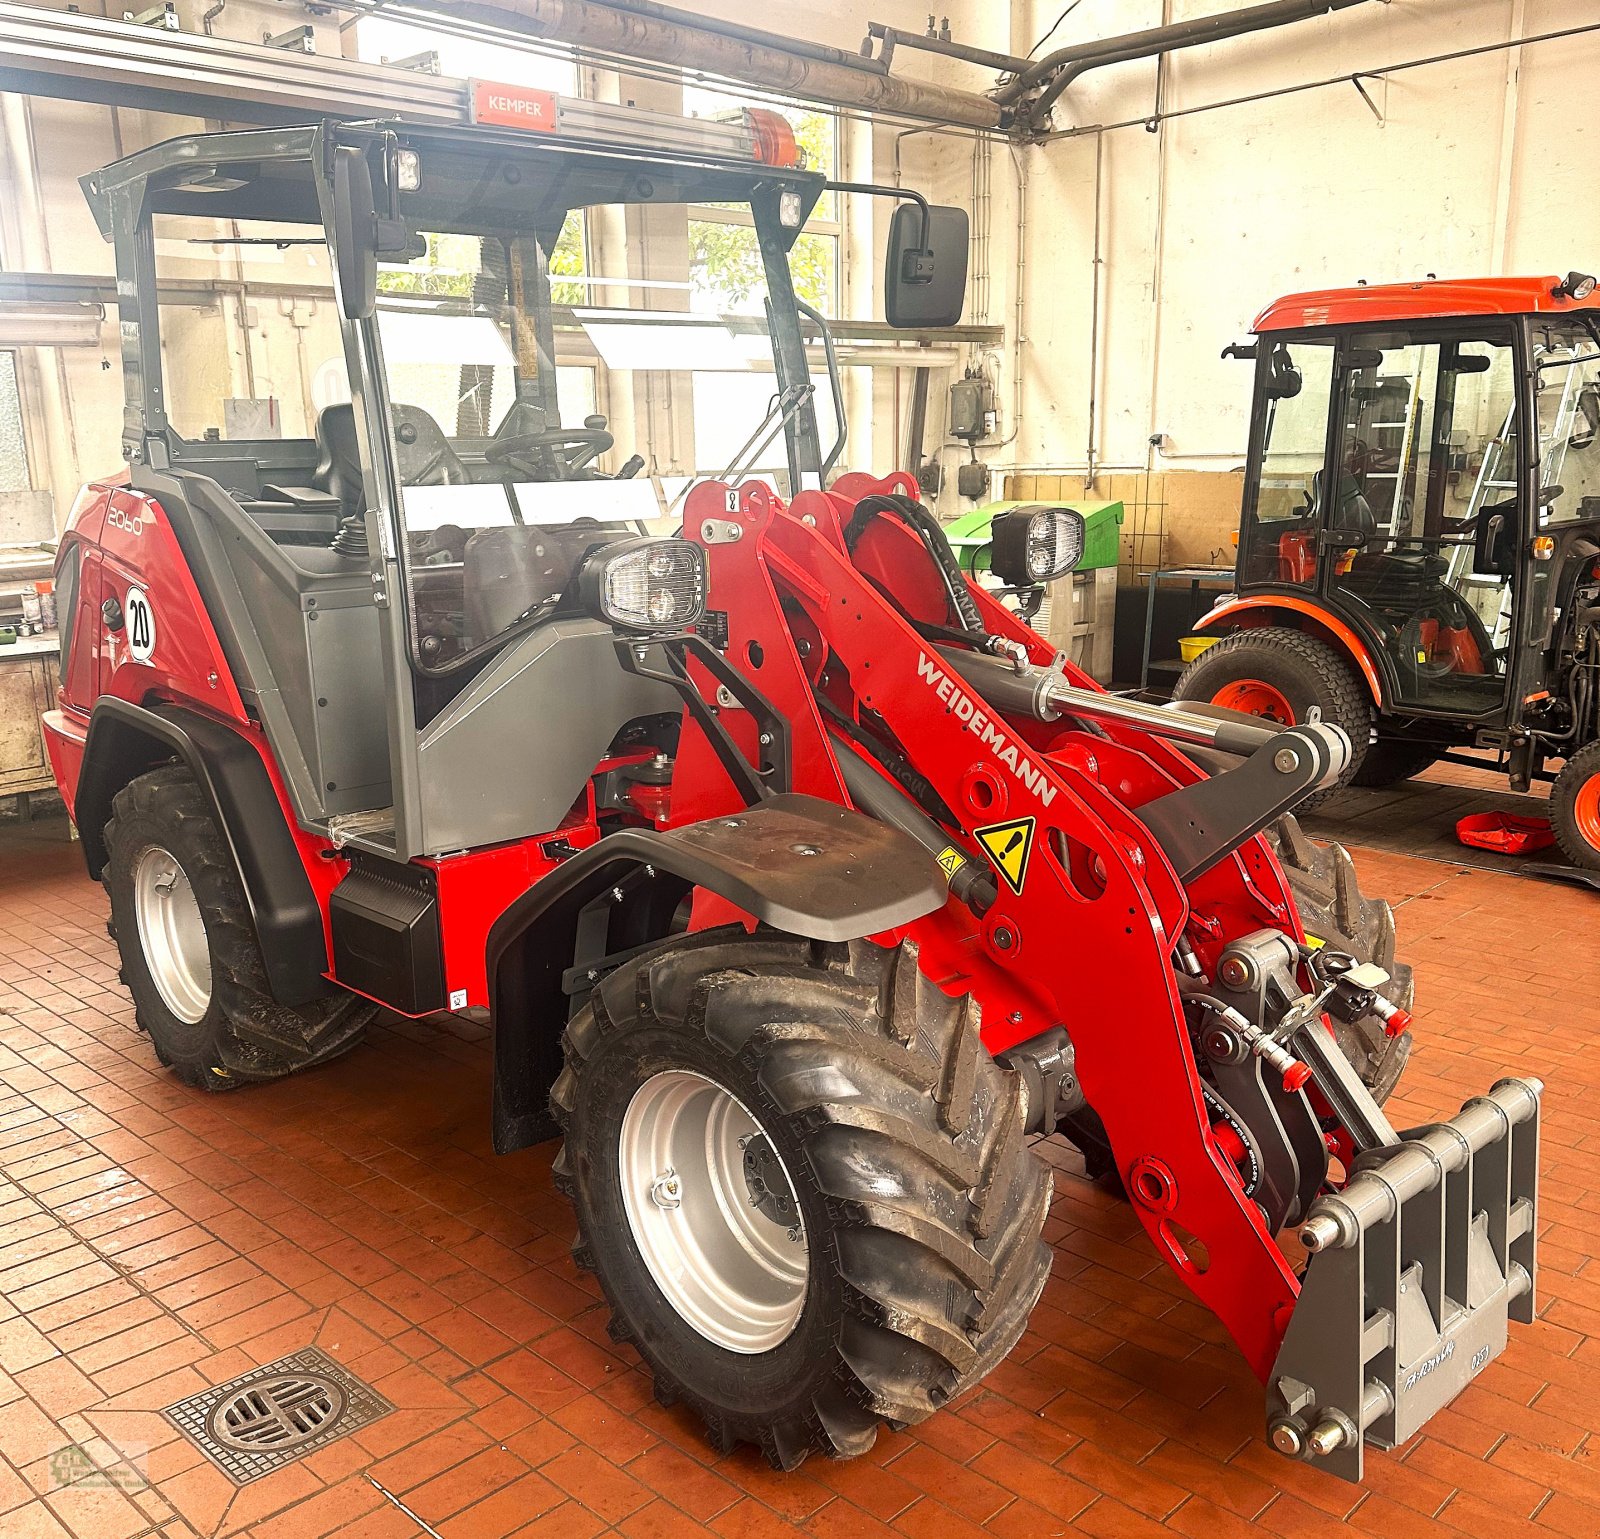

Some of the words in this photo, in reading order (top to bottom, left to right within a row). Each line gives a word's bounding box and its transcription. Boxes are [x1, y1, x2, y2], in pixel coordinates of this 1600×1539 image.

[489, 95, 542, 116] KEMPER
[107, 507, 143, 536] 2060
[130, 600, 150, 649] 20
[917, 651, 1058, 808] WEIDEMANN
